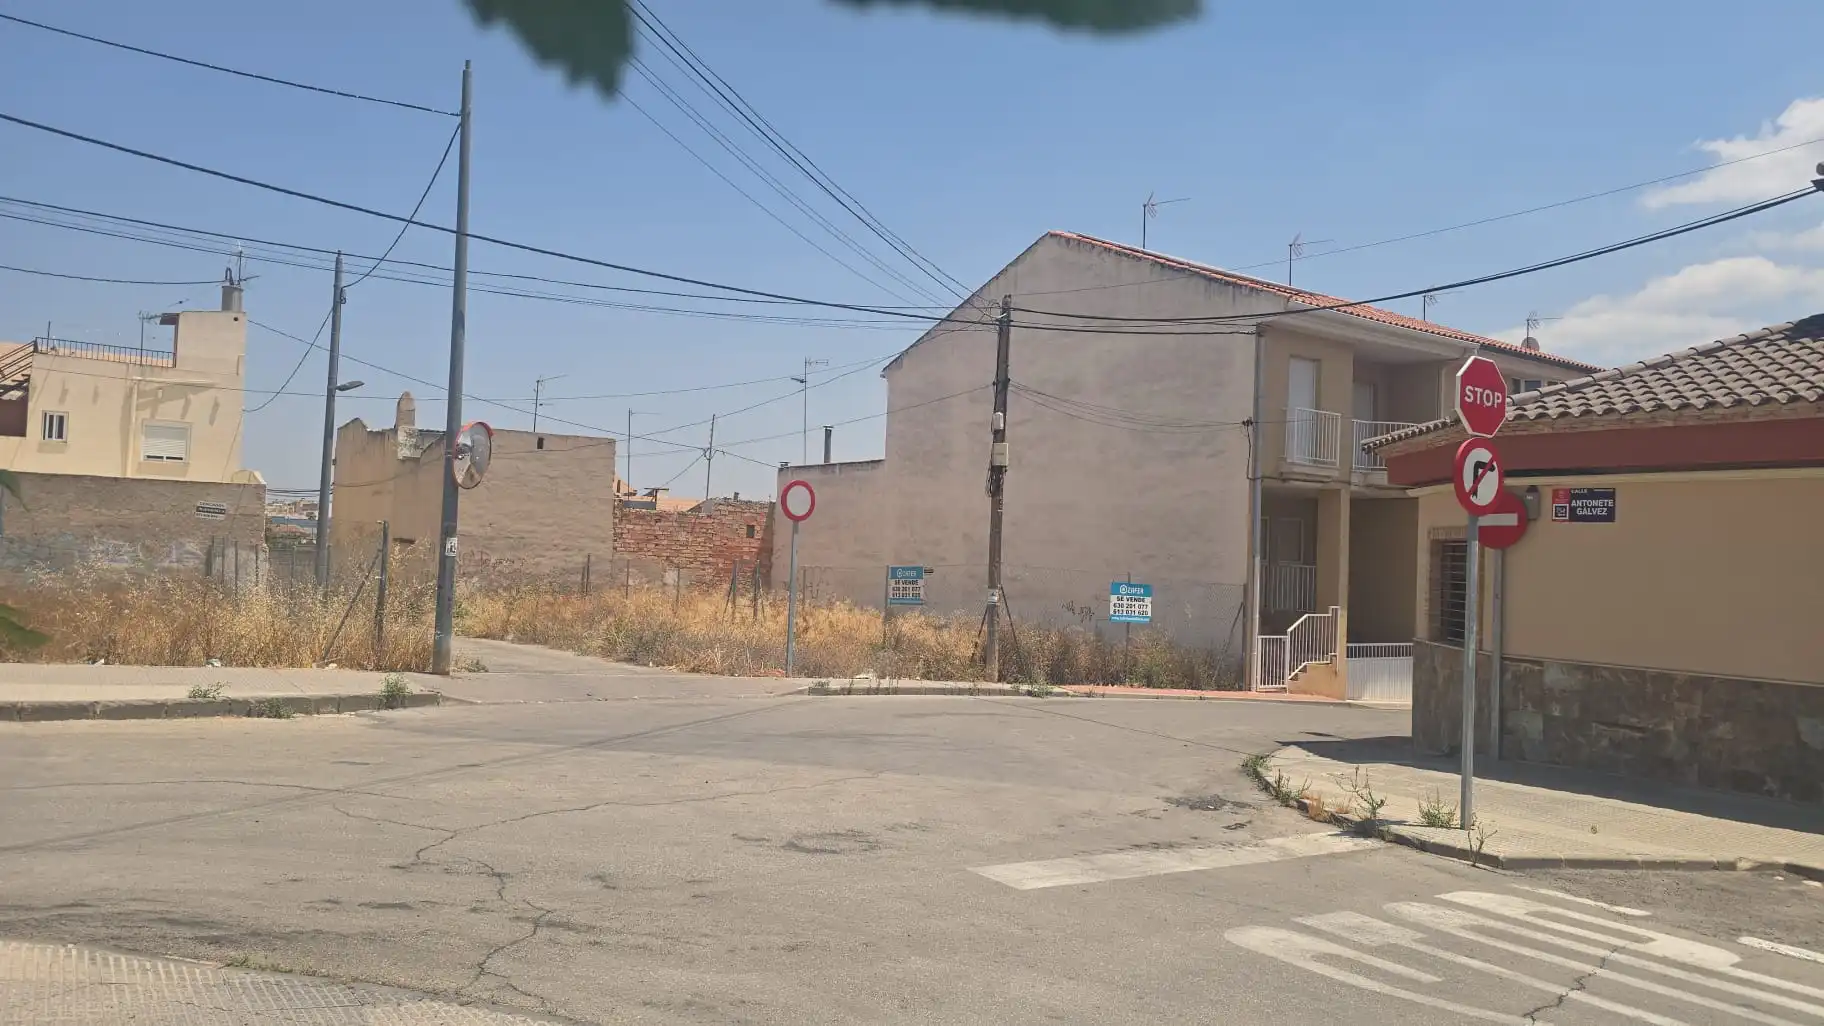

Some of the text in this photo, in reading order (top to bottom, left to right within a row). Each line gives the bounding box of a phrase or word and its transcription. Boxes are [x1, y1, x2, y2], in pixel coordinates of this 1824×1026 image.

[1464, 385, 1502, 408] STOP
[1571, 499, 1614, 507] ANTONETE
[1576, 506, 1608, 515] GÁLVEZ
